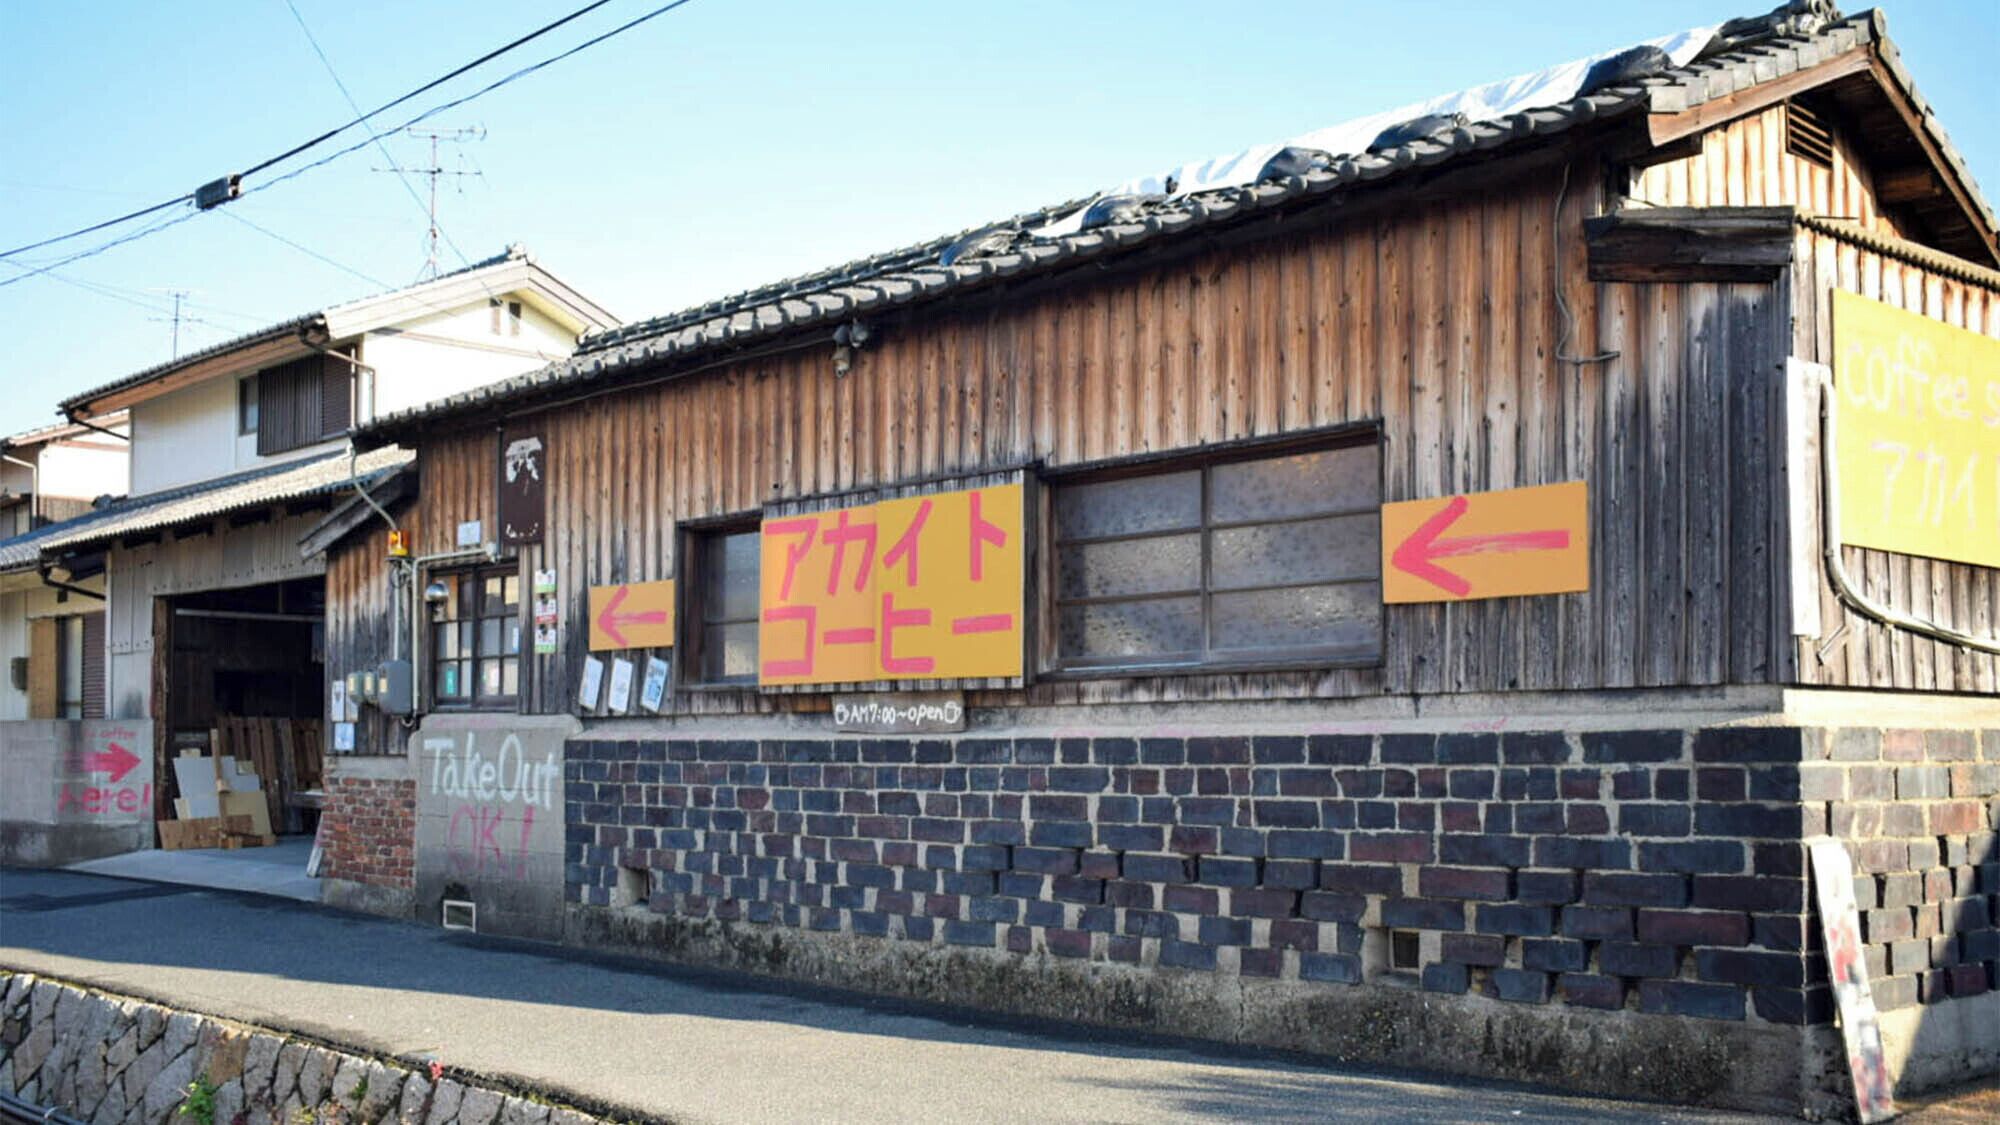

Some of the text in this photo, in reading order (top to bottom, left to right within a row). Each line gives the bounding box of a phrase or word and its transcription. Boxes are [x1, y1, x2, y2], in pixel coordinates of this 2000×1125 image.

[1843, 331, 1971, 418] coffee
[1871, 441, 2000, 532] アカイ
[764, 491, 1007, 601] アカイト
[762, 592, 1013, 677] コーヒー
